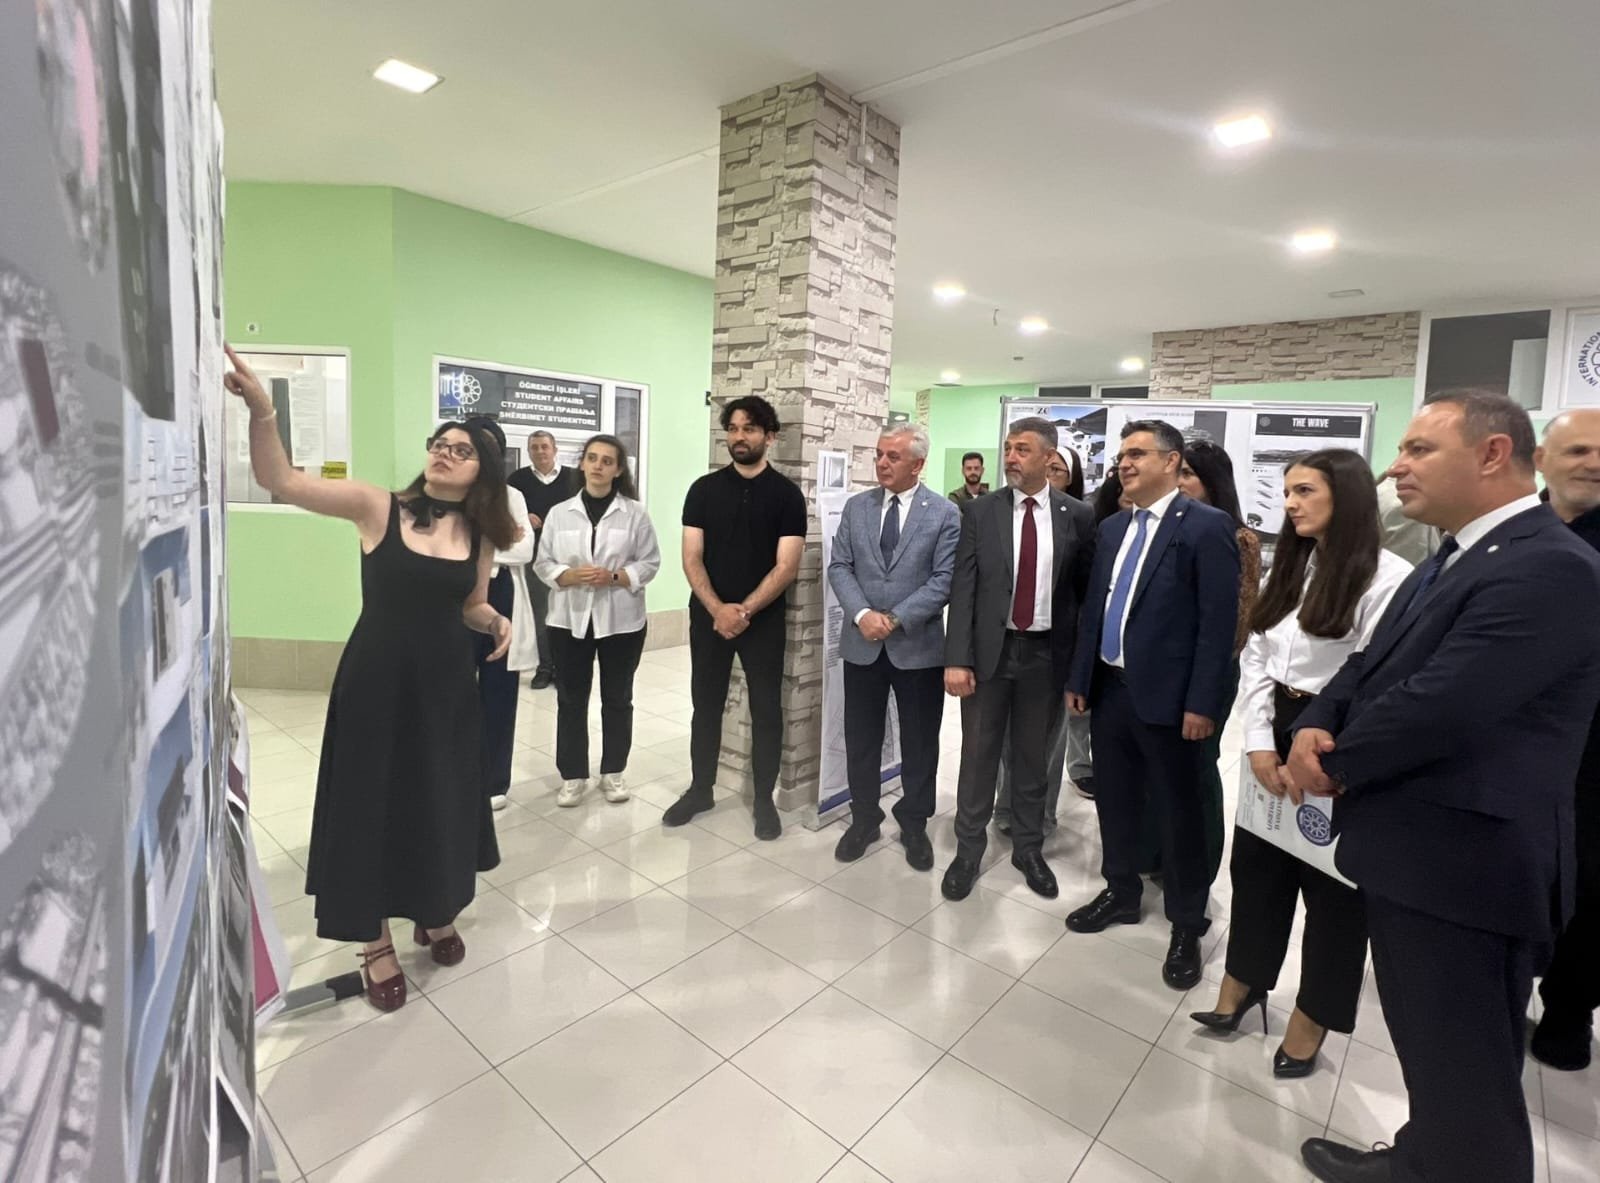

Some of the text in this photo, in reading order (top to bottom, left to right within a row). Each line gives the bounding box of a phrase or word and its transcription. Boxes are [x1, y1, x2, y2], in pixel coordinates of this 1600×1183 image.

[515, 392, 584, 405] STUDENT AFFAIRS
[547, 415, 597, 426] STUDENTORE
[1292, 417, 1329, 428] THE WAVE
